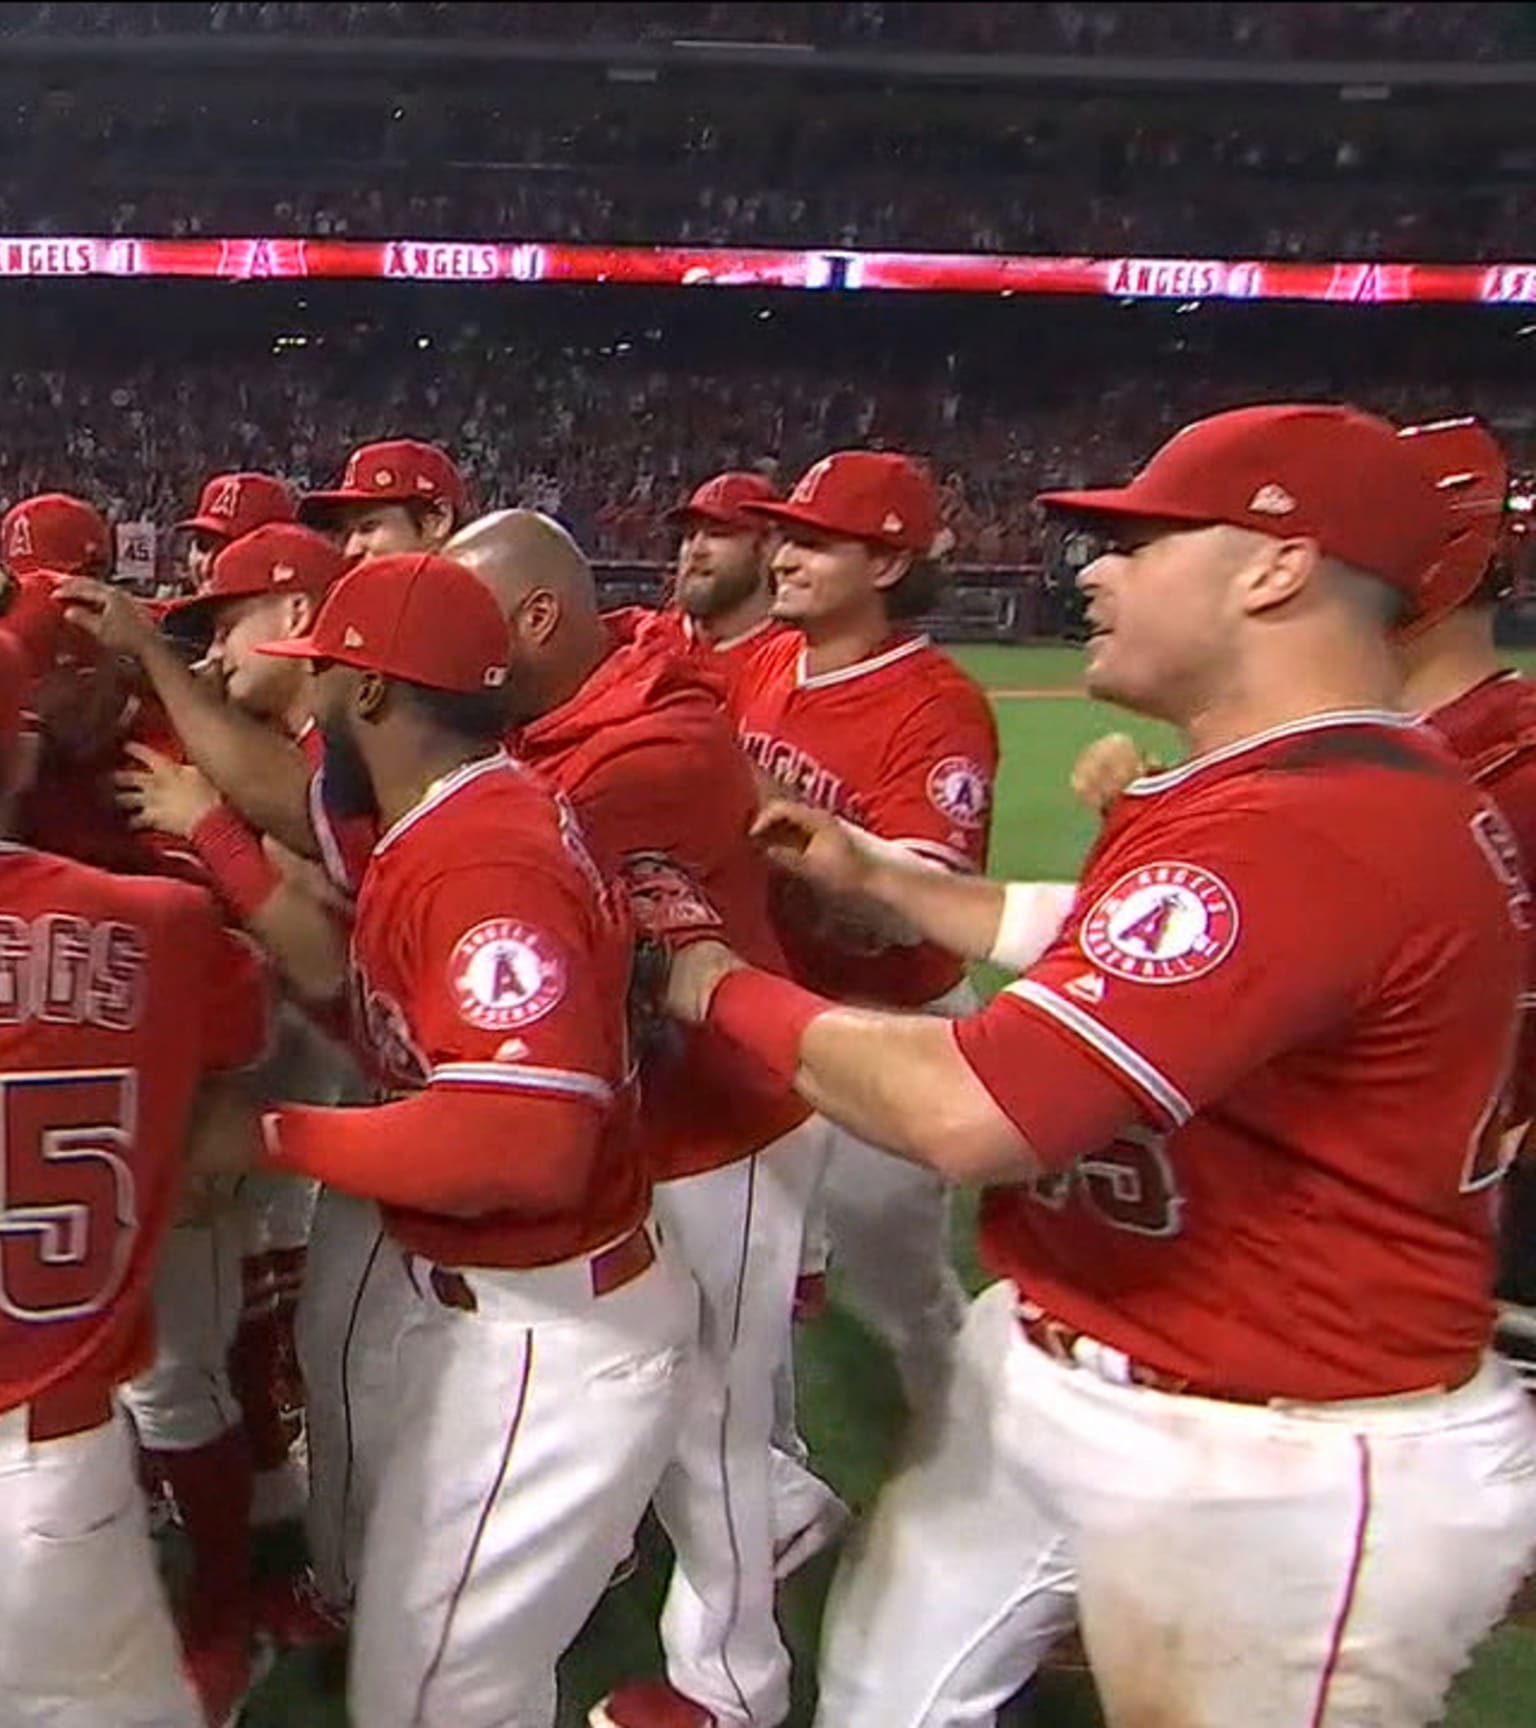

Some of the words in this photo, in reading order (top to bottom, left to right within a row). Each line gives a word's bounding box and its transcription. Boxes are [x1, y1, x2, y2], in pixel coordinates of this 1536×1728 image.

[387, 243, 494, 276] ANGELS
[1115, 258, 1215, 294] ANGELS
[491, 945, 527, 1002] A
